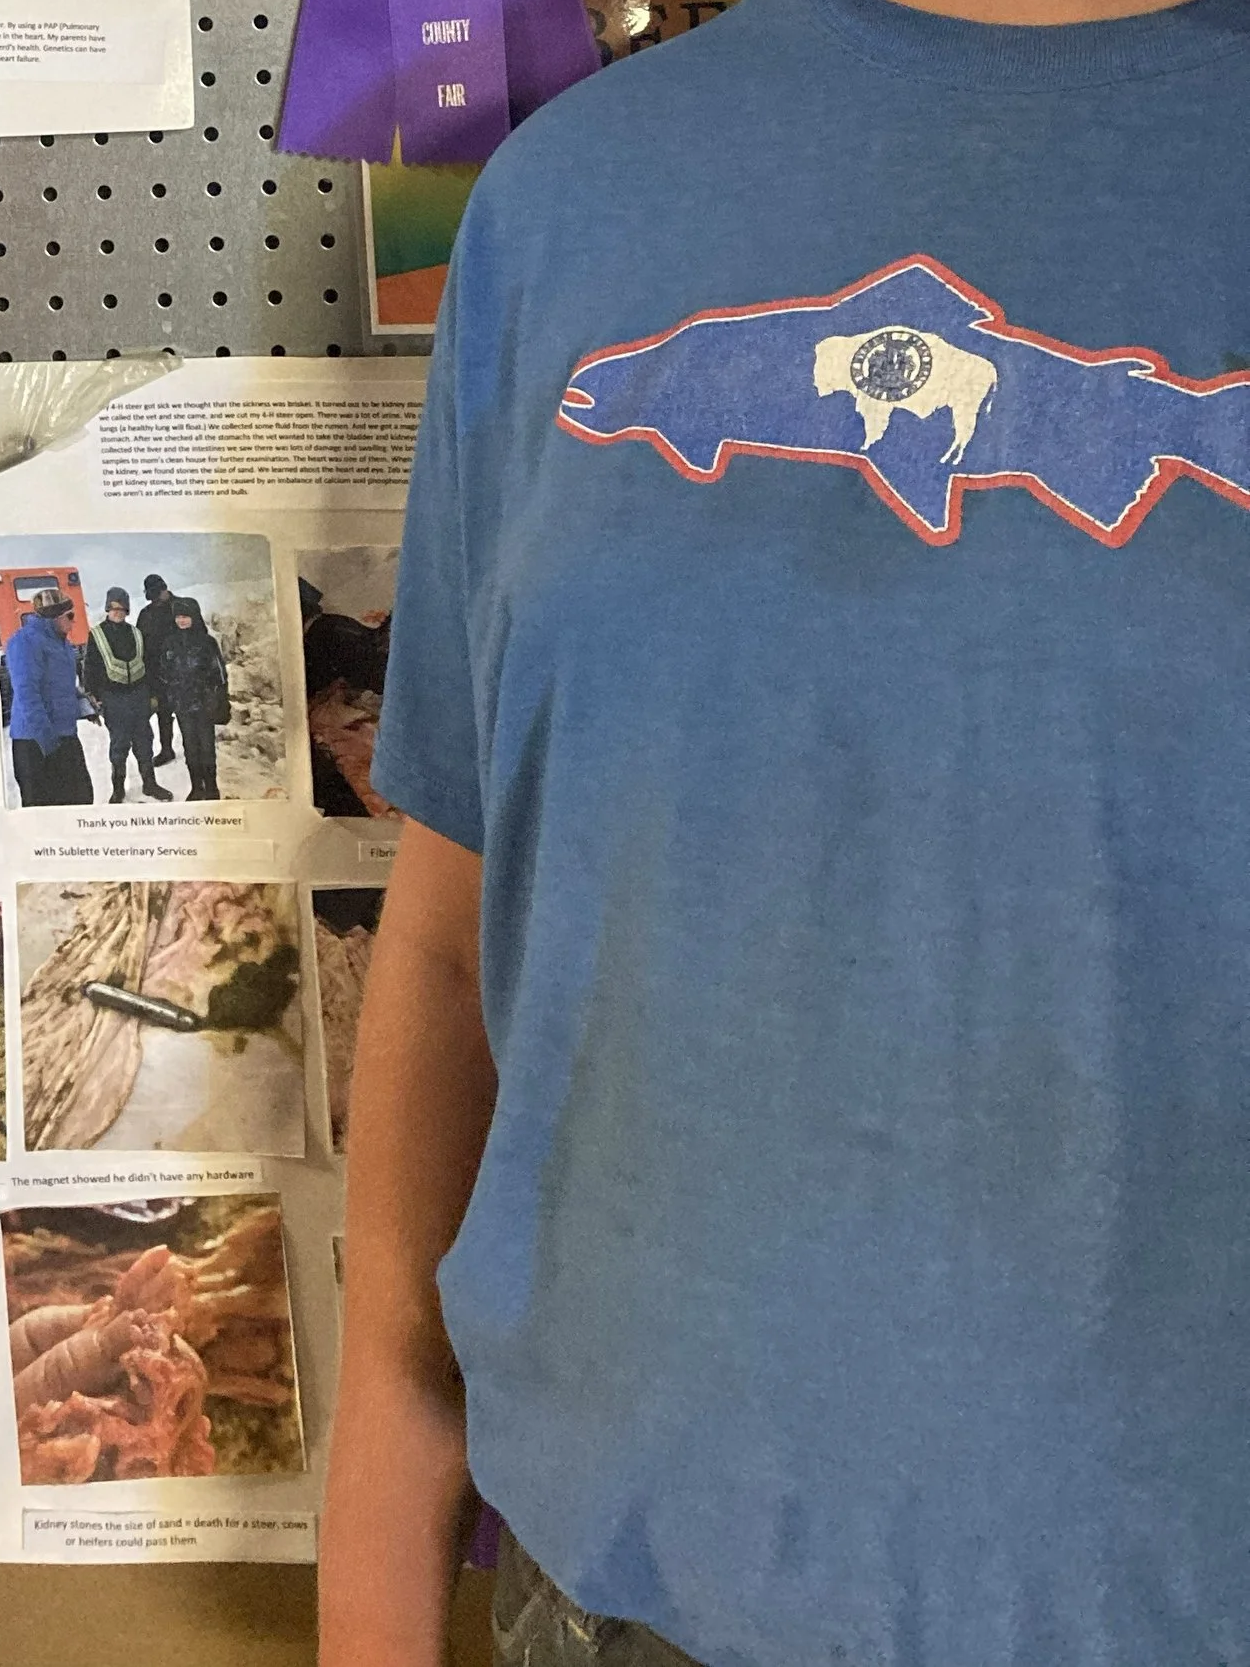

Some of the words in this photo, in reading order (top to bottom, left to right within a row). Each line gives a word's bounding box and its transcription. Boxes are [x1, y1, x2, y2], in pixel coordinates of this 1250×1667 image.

[421, 18, 471, 46] COUNTY
[437, 83, 467, 109] FAIR
[76, 817, 108, 829] Thank
[108, 819, 128, 830] you
[130, 816, 156, 827] Nikki
[157, 816, 243, 826] Marincic-Weaver
[33, 846, 57, 857] with
[58, 846, 100, 857] Sublette
[102, 846, 155, 858] Veterinary
[156, 846, 198, 857] Services
[10, 1177, 30, 1186] The
[31, 1175, 70, 1188] magnet
[71, 1173, 111, 1185] showed
[112, 1173, 126, 1183] he
[127, 1172, 158, 1183] didn't
[159, 1172, 184, 1182] have
[185, 1173, 205, 1183] any
[205, 1169, 255, 1180] hardware
